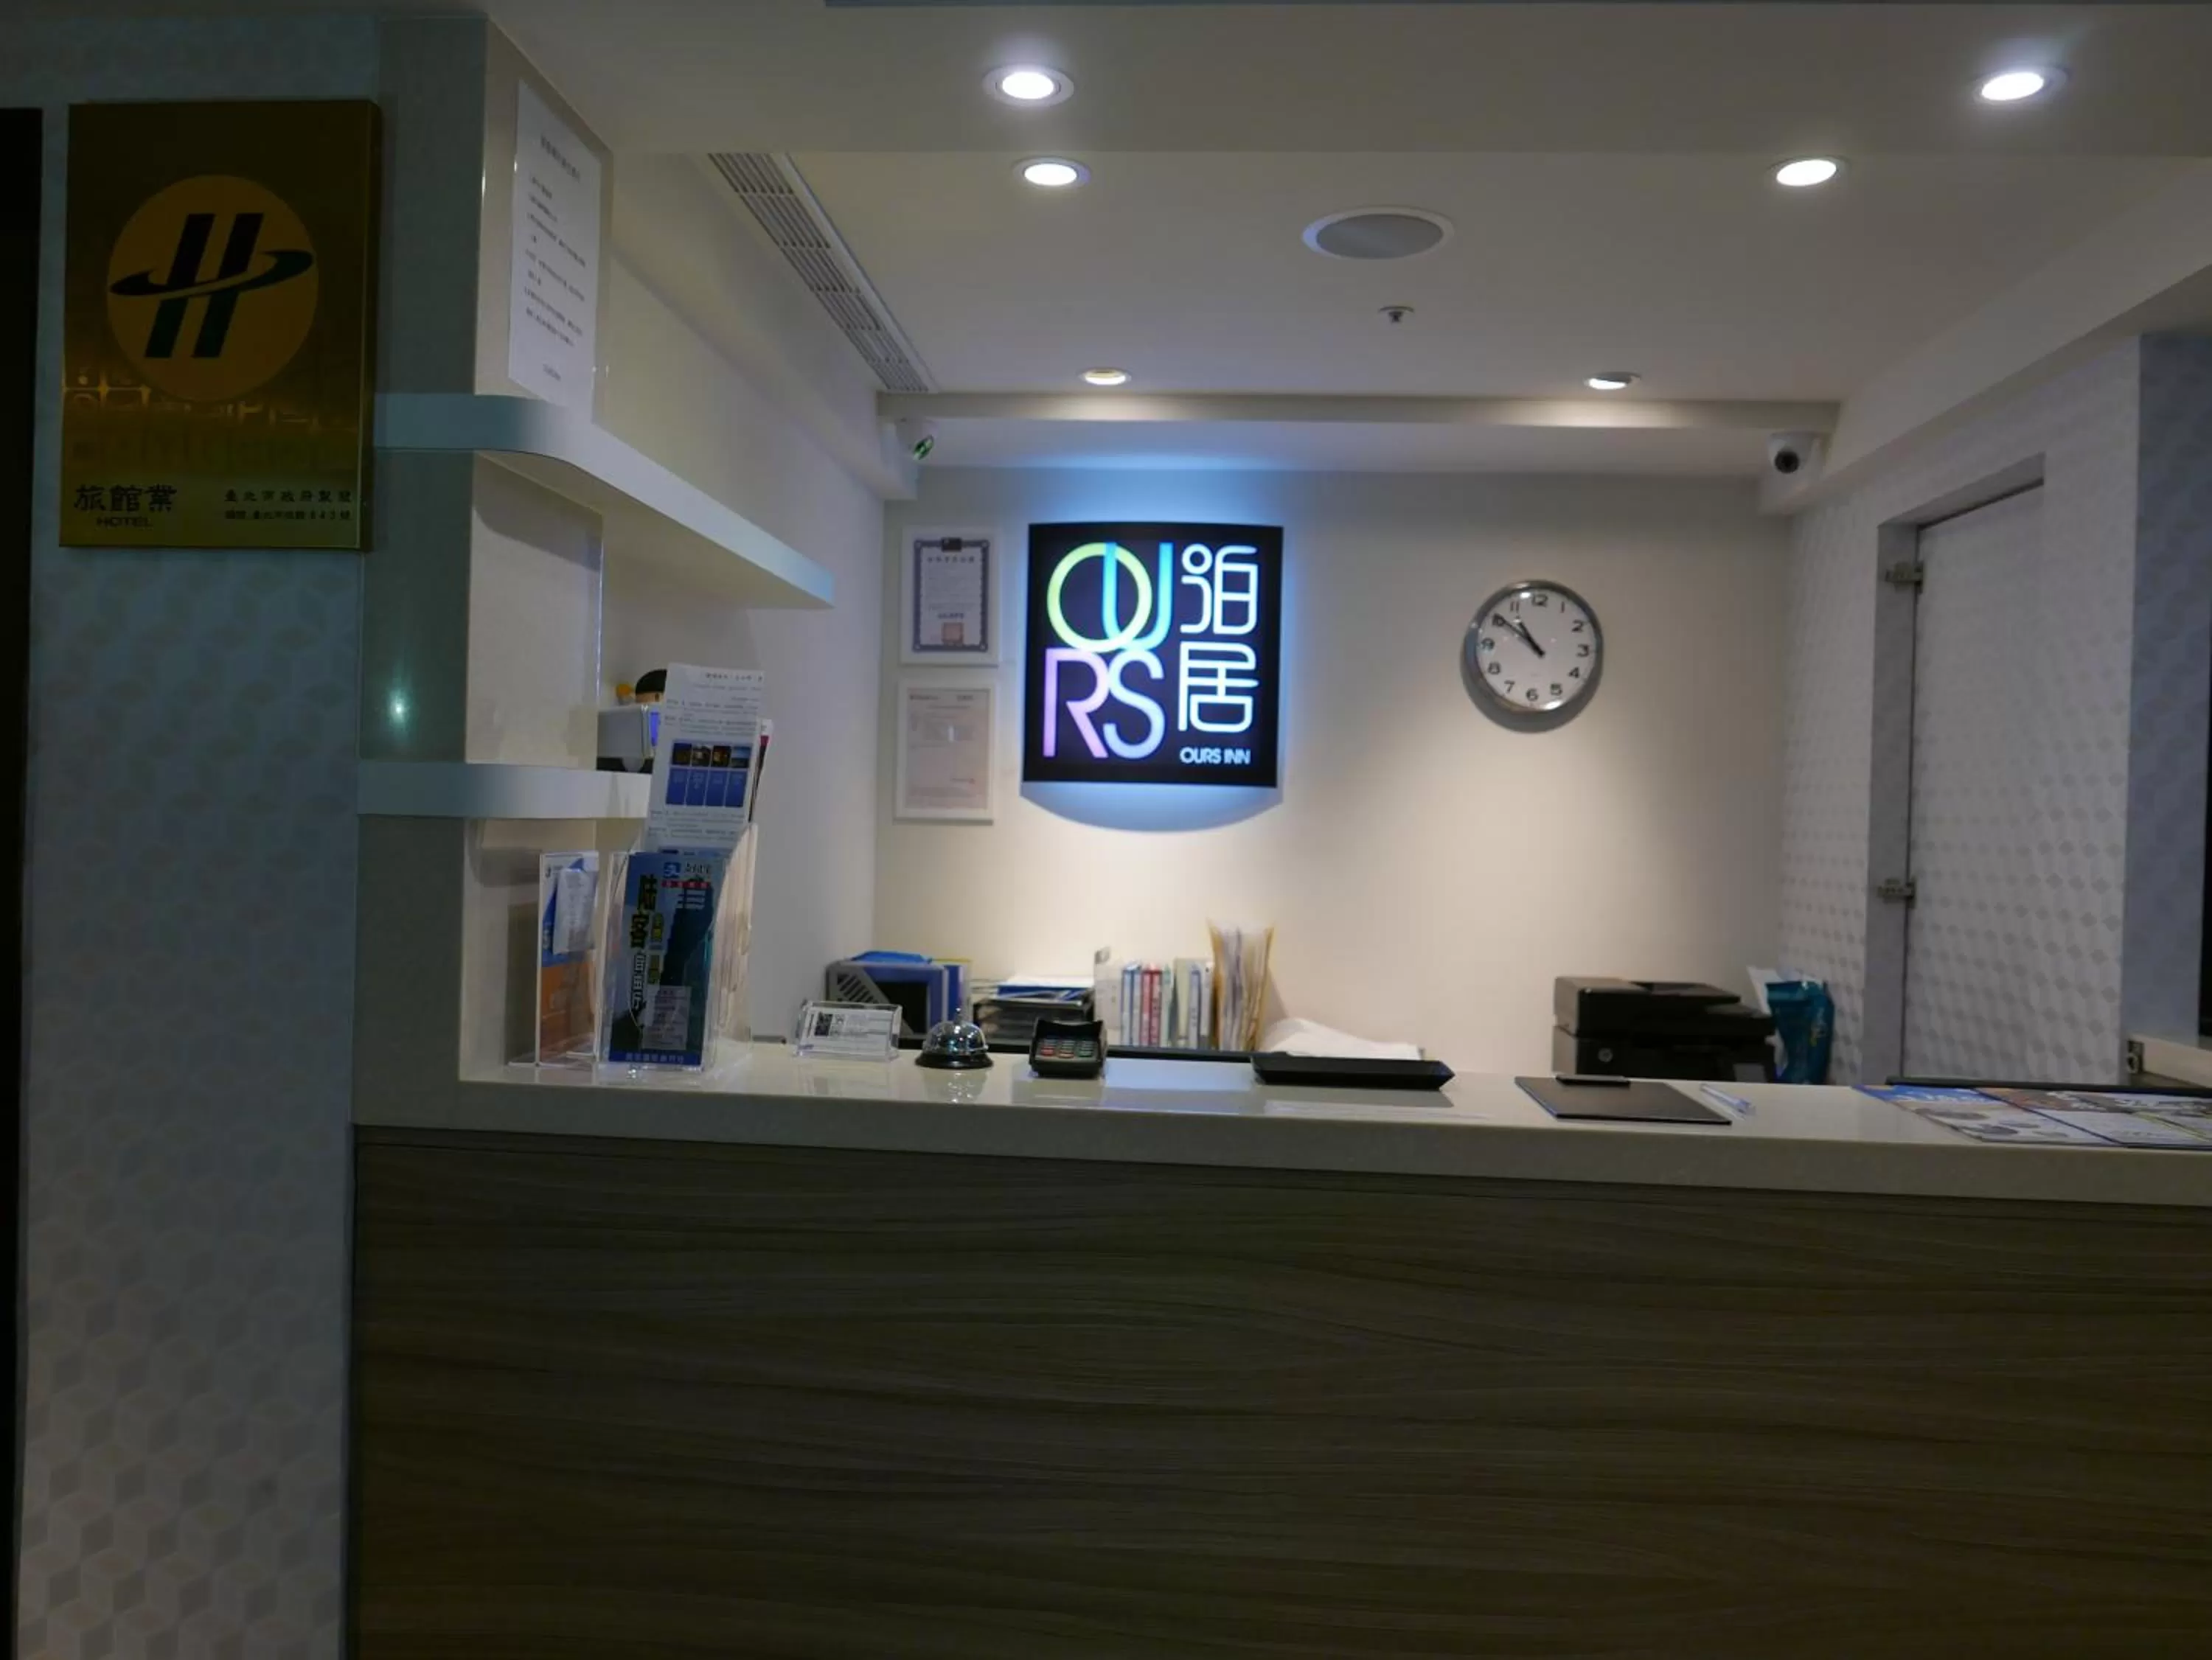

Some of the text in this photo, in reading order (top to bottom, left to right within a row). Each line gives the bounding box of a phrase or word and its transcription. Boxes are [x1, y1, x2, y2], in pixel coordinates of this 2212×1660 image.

[73, 484, 178, 512] 旅館業
[96, 517, 154, 529] HOTEL
[1509, 601, 1520, 613] 11
[1531, 593, 1548, 608] 12
[1559, 601, 1566, 614] 1
[1571, 618, 1585, 632] 2
[1481, 637, 1495, 651] 9
[1576, 644, 1590, 658] 3
[1487, 662, 1501, 675] 8
[1568, 666, 1581, 679] 4
[1503, 680, 1516, 694] 7
[1550, 683, 1563, 697] 5
[1526, 688, 1540, 702] 6
[1179, 746, 1252, 765] OURS INN
